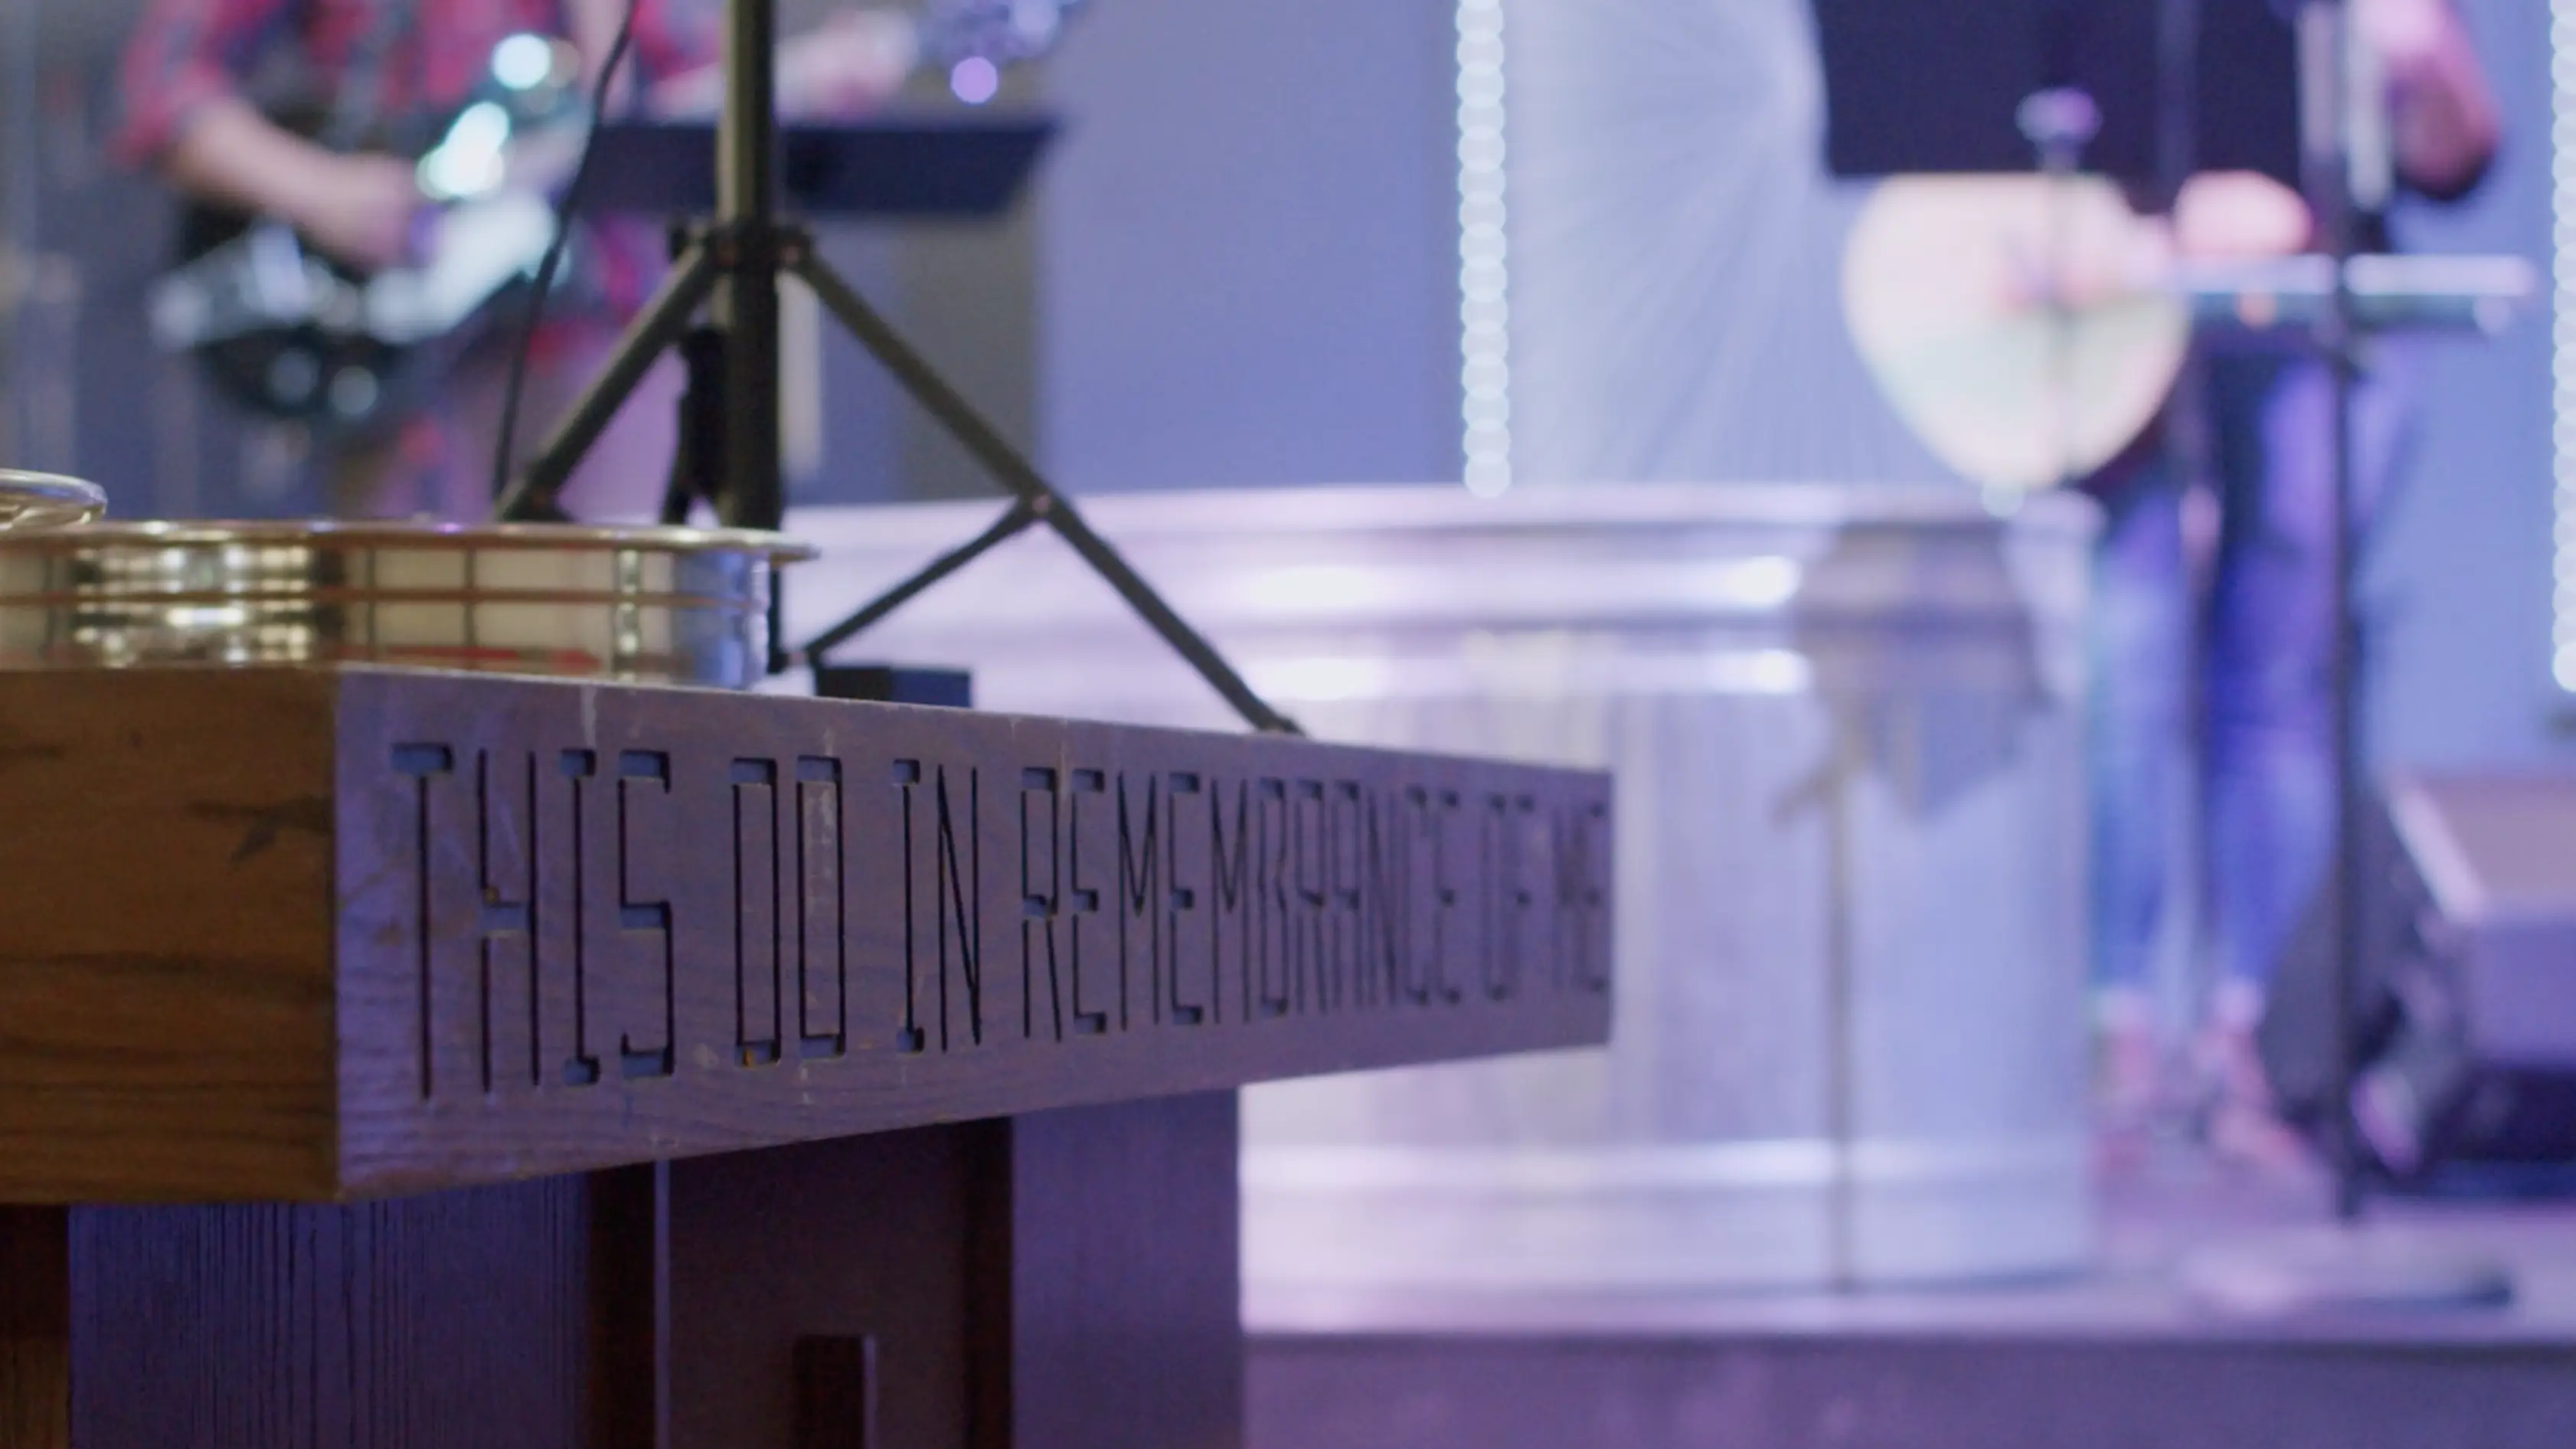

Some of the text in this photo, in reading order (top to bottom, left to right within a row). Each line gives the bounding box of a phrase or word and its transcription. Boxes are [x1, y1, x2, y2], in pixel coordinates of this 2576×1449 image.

[391, 742, 675, 1098] THIS
[731, 755, 845, 1066] DO
[893, 758, 981, 1054] IN
[1021, 767, 1460, 1042] REMEMBRANCE
[1482, 792, 1534, 1001] OF
